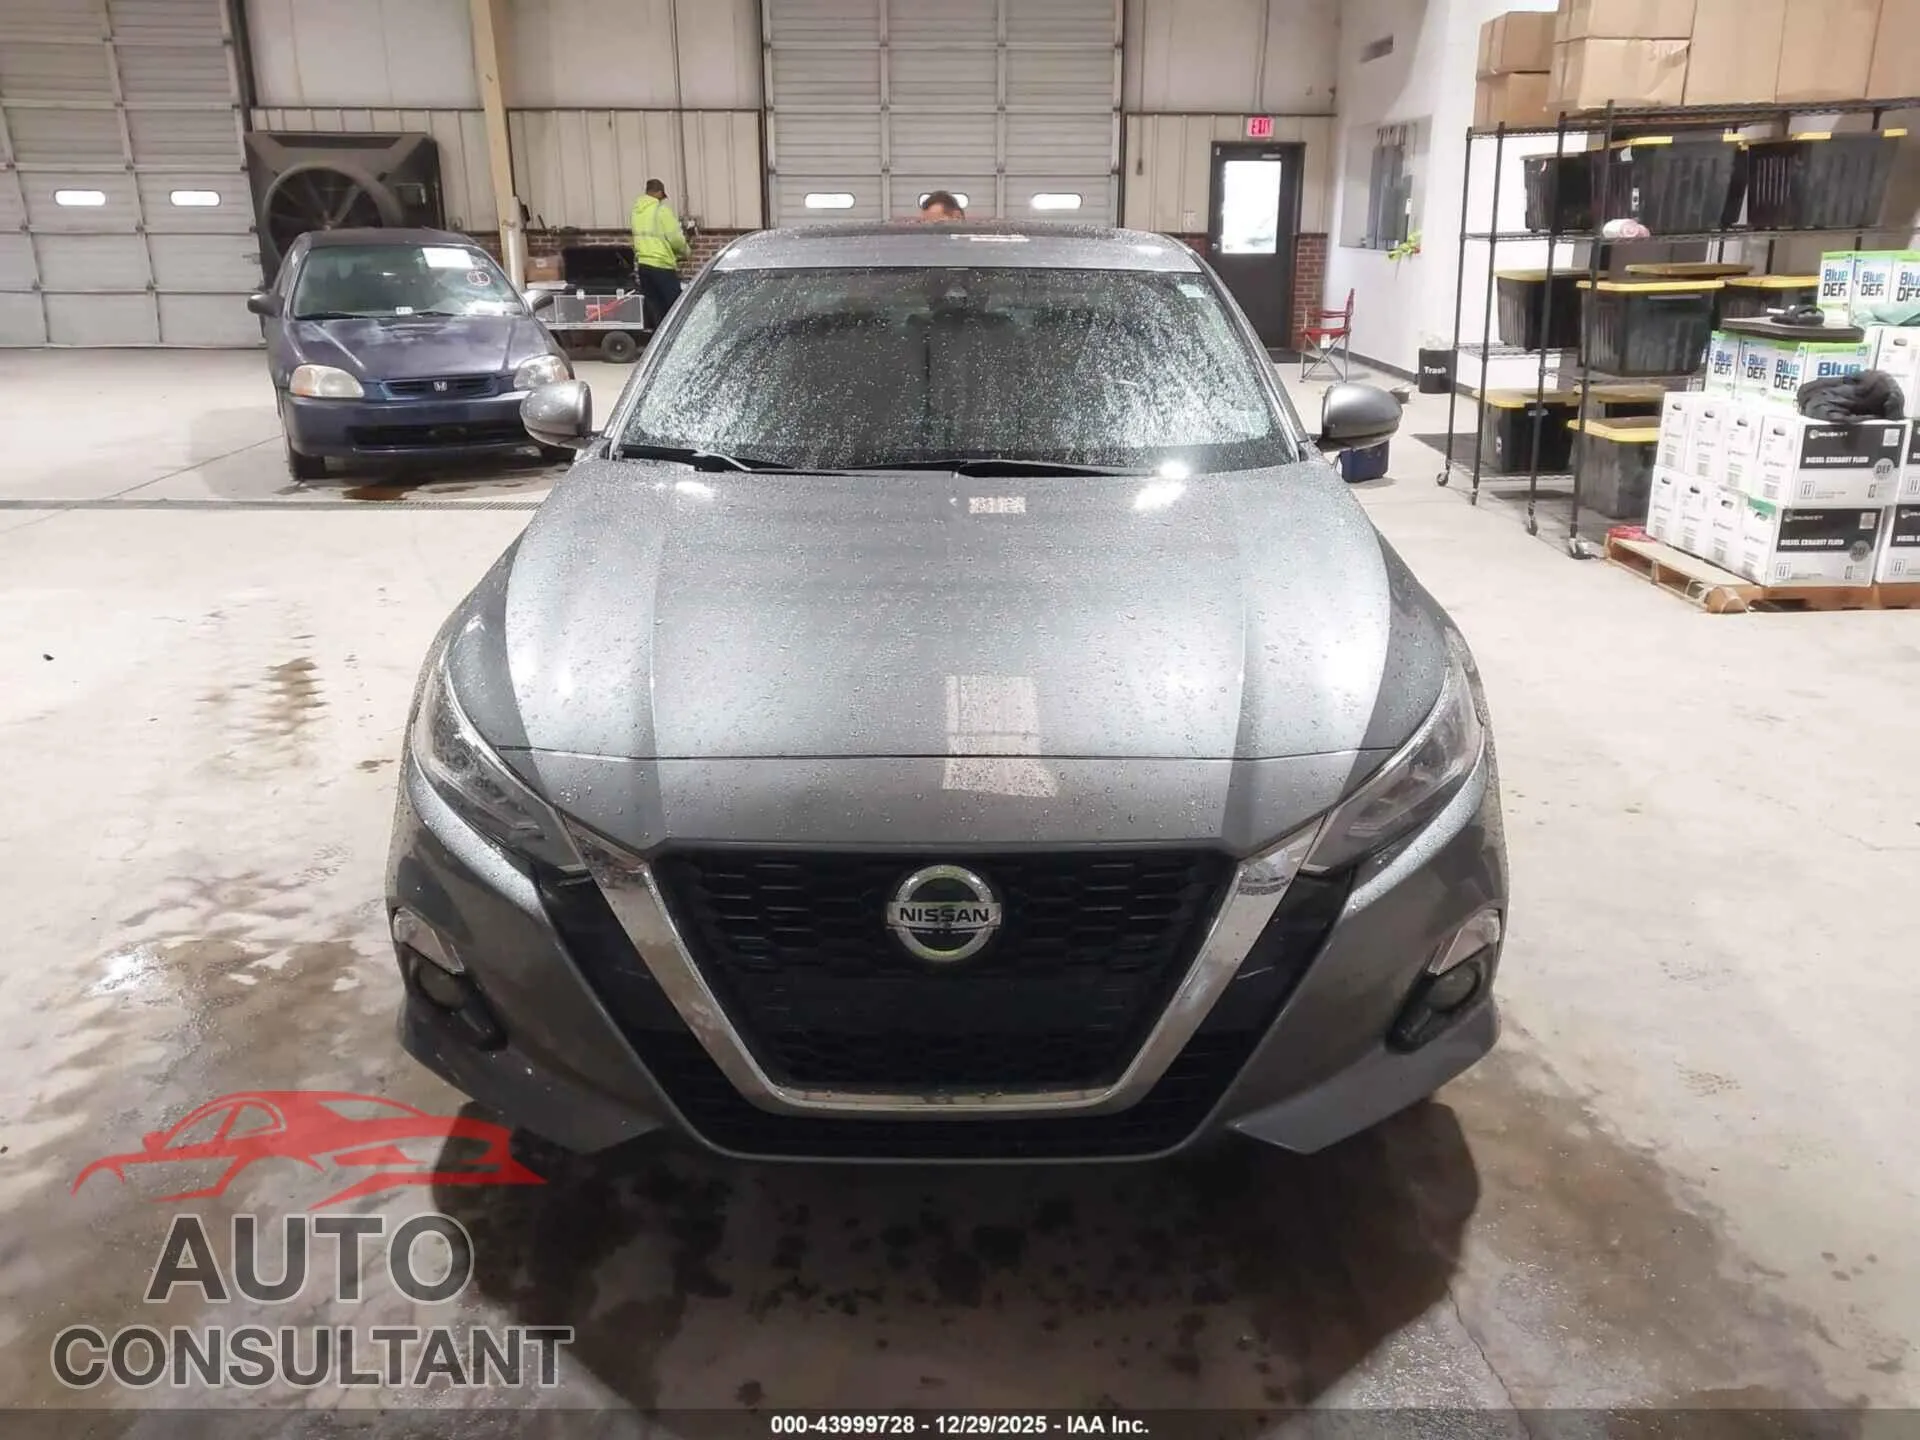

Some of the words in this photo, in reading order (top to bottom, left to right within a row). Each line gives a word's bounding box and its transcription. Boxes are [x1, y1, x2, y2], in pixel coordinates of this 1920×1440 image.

[1251, 119, 1271, 135] EXIT
[1824, 268, 1848, 281] Blue
[1862, 271, 1885, 283] Blue
[1900, 272, 1920, 286] Blu
[1823, 283, 1847, 297] DEF
[1860, 284, 1884, 296] DEF
[1715, 351, 1733, 363] Blue
[1748, 354, 1768, 366] Blue
[1424, 366, 1447, 374] Trash
[1713, 363, 1732, 377] DEF
[1746, 366, 1767, 382] DEF
[1776, 359, 1799, 375] Blue
[1817, 362, 1861, 377] Blue
[1773, 374, 1798, 392] DEF
[1825, 456, 1852, 464] EXHAUST
[1876, 465, 1891, 474] DEF
[899, 907, 990, 923] NISSAN
